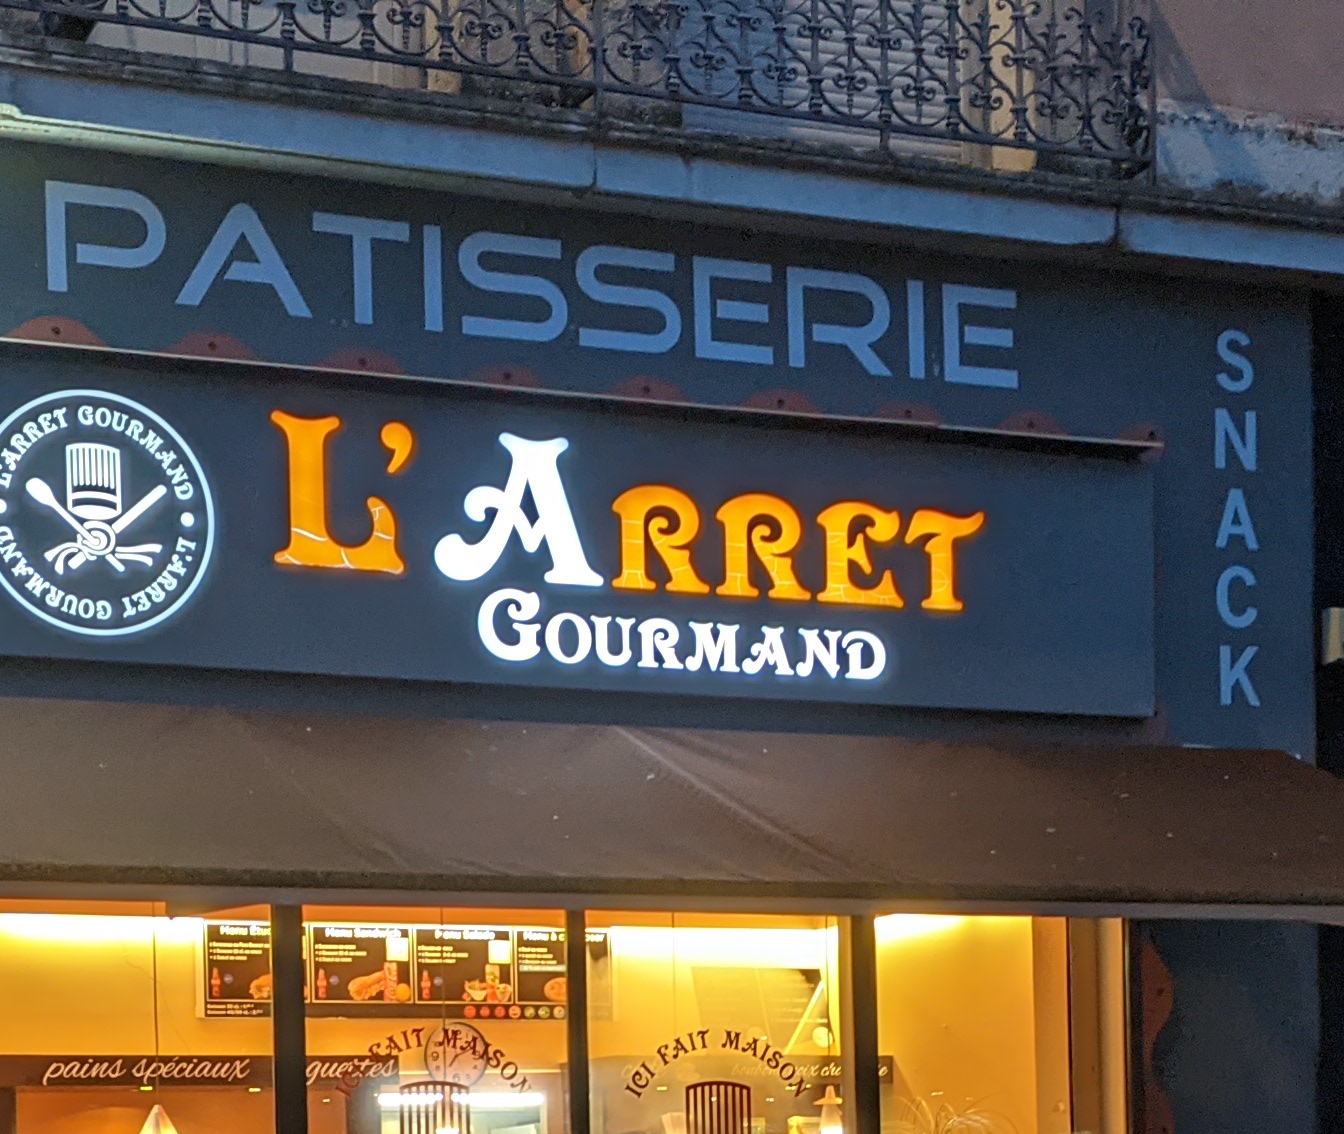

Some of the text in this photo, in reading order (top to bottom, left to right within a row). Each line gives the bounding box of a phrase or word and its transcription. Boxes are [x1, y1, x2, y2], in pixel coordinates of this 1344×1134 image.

[43, 179, 1020, 390] PATISSERIE
[78, 405, 195, 501] GOURMAND
[1213, 330, 1259, 707] SNACK
[122, 536, 197, 618] L'ARRET
[475, 590, 888, 683] GOURMAND
[43, 1056, 251, 1086] pains spéciaux
[368, 1027, 425, 1063] FAIT
[438, 1028, 533, 1095] MAISON
[625, 1061, 656, 1099] ICI
[656, 1029, 710, 1067] FAIT
[721, 1030, 810, 1099] MAISON
